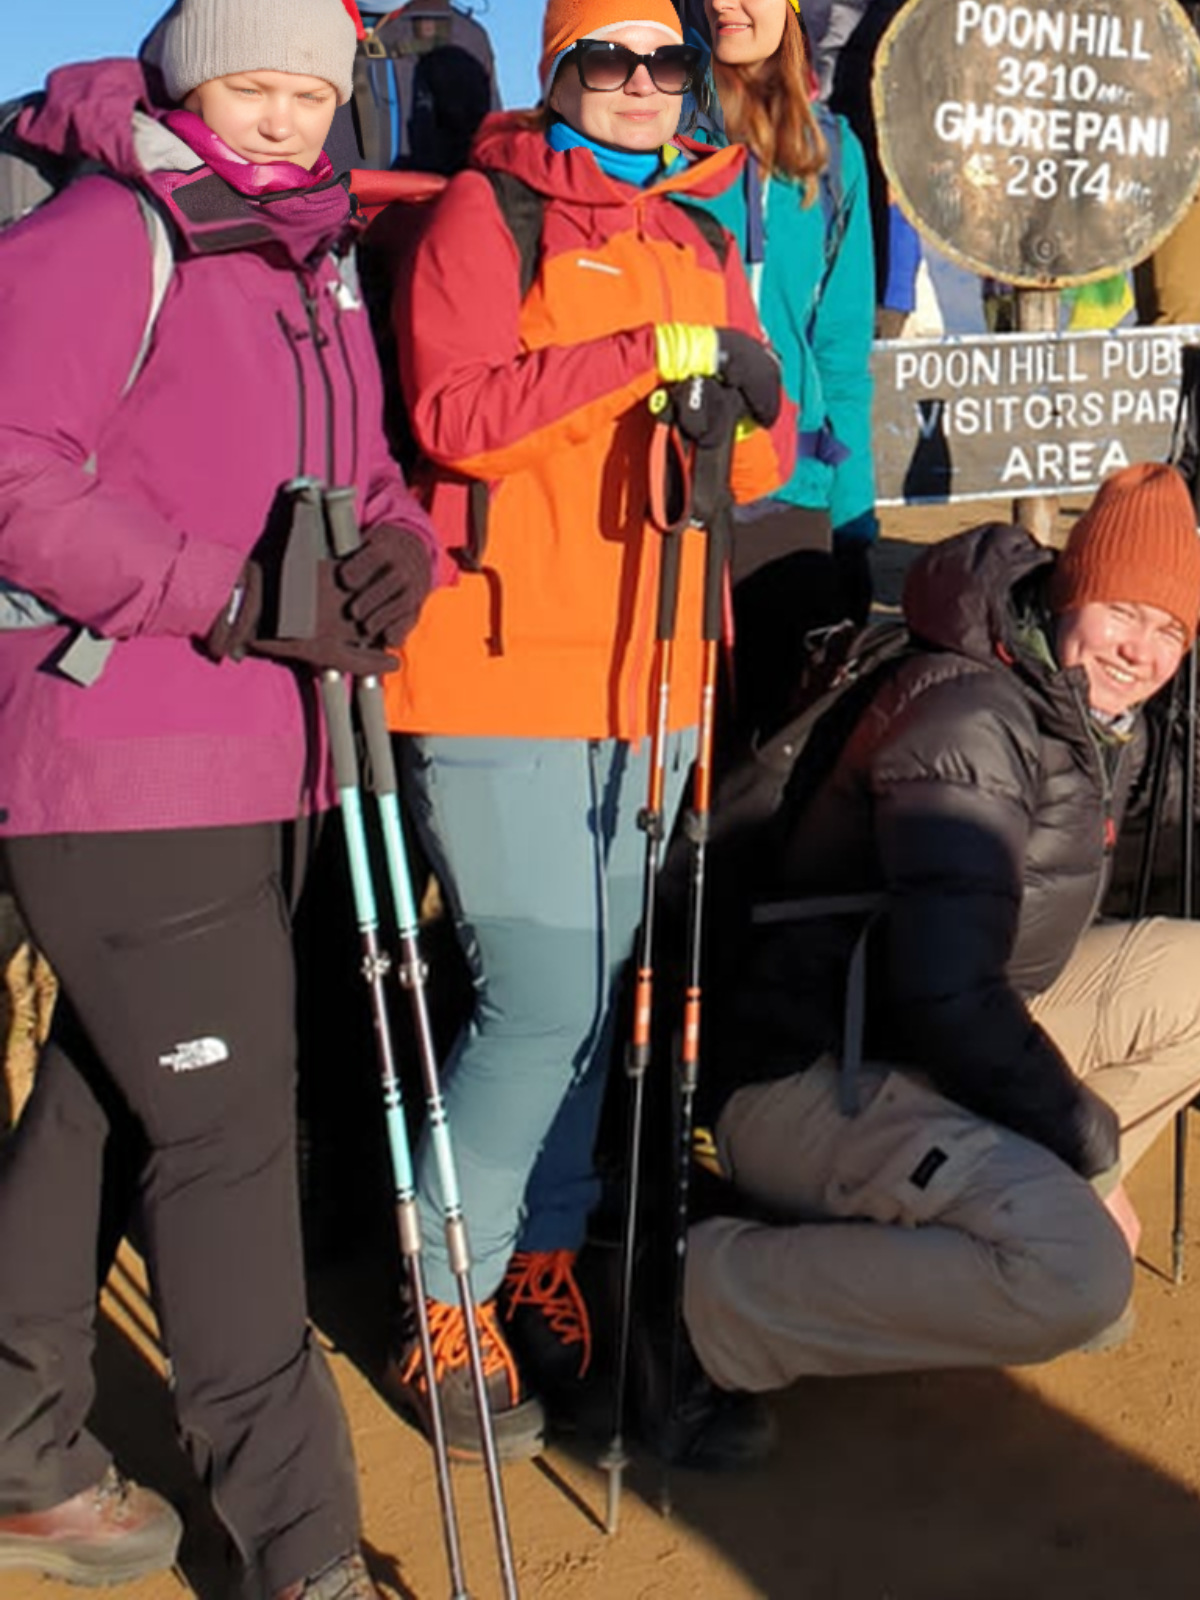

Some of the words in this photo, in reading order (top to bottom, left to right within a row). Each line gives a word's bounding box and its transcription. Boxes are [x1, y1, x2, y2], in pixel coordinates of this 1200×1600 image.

[995, 56, 1098, 101] 3210
[934, 102, 1169, 157] GHOREPANI
[1006, 155, 1111, 203] 2874
[1001, 440, 1130, 483] AREA
